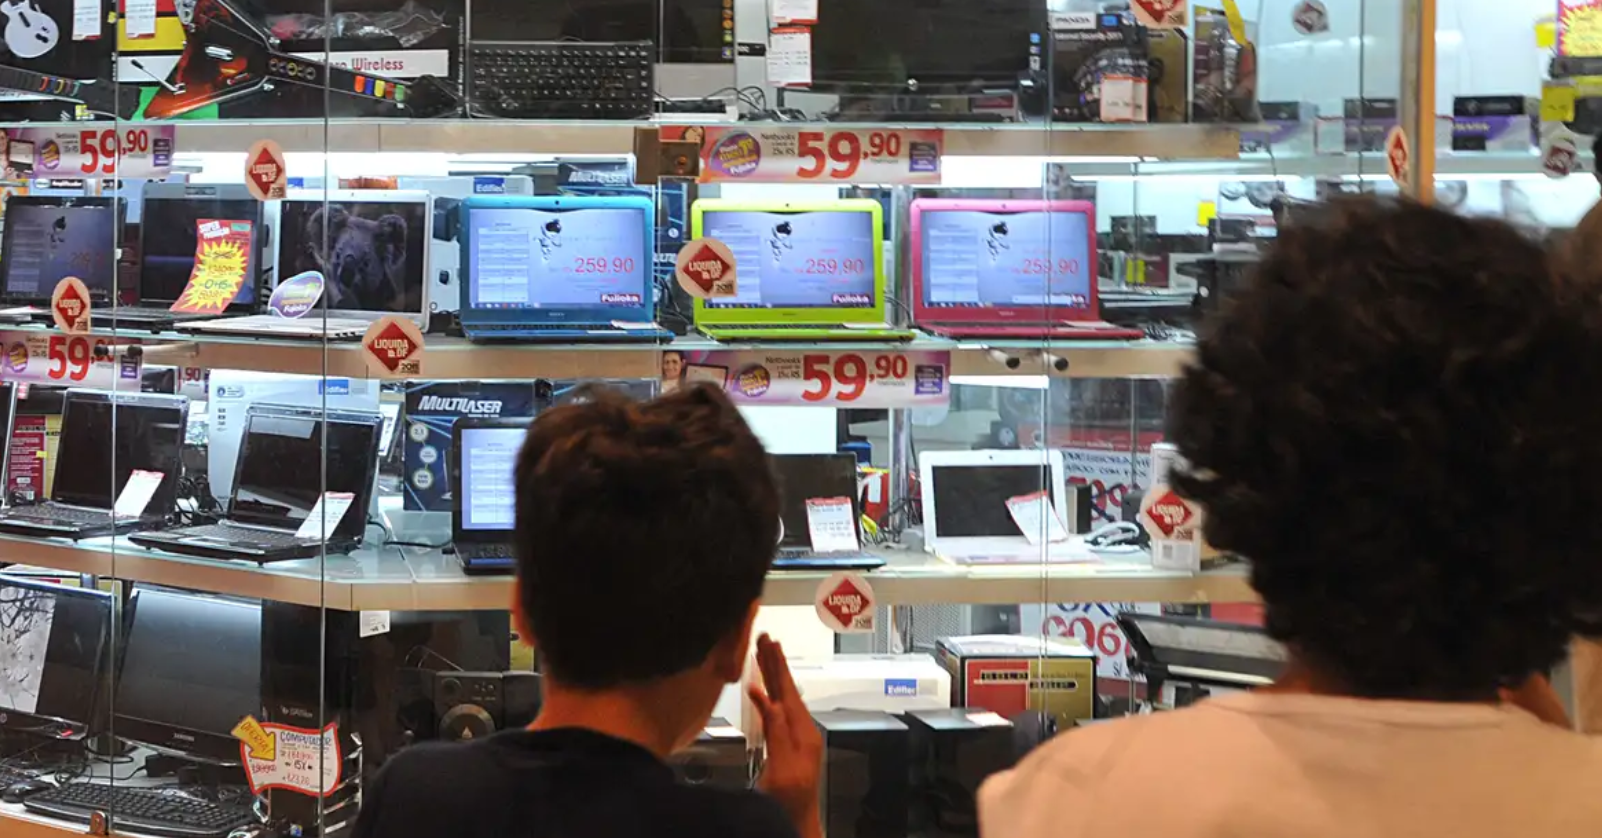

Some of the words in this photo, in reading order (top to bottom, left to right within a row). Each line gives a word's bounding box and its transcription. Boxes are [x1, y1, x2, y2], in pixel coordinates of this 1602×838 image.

[352, 57, 404, 71] Wireless
[374, 338, 409, 350] LIQUIDA
[418, 395, 502, 414] MULTILASER
